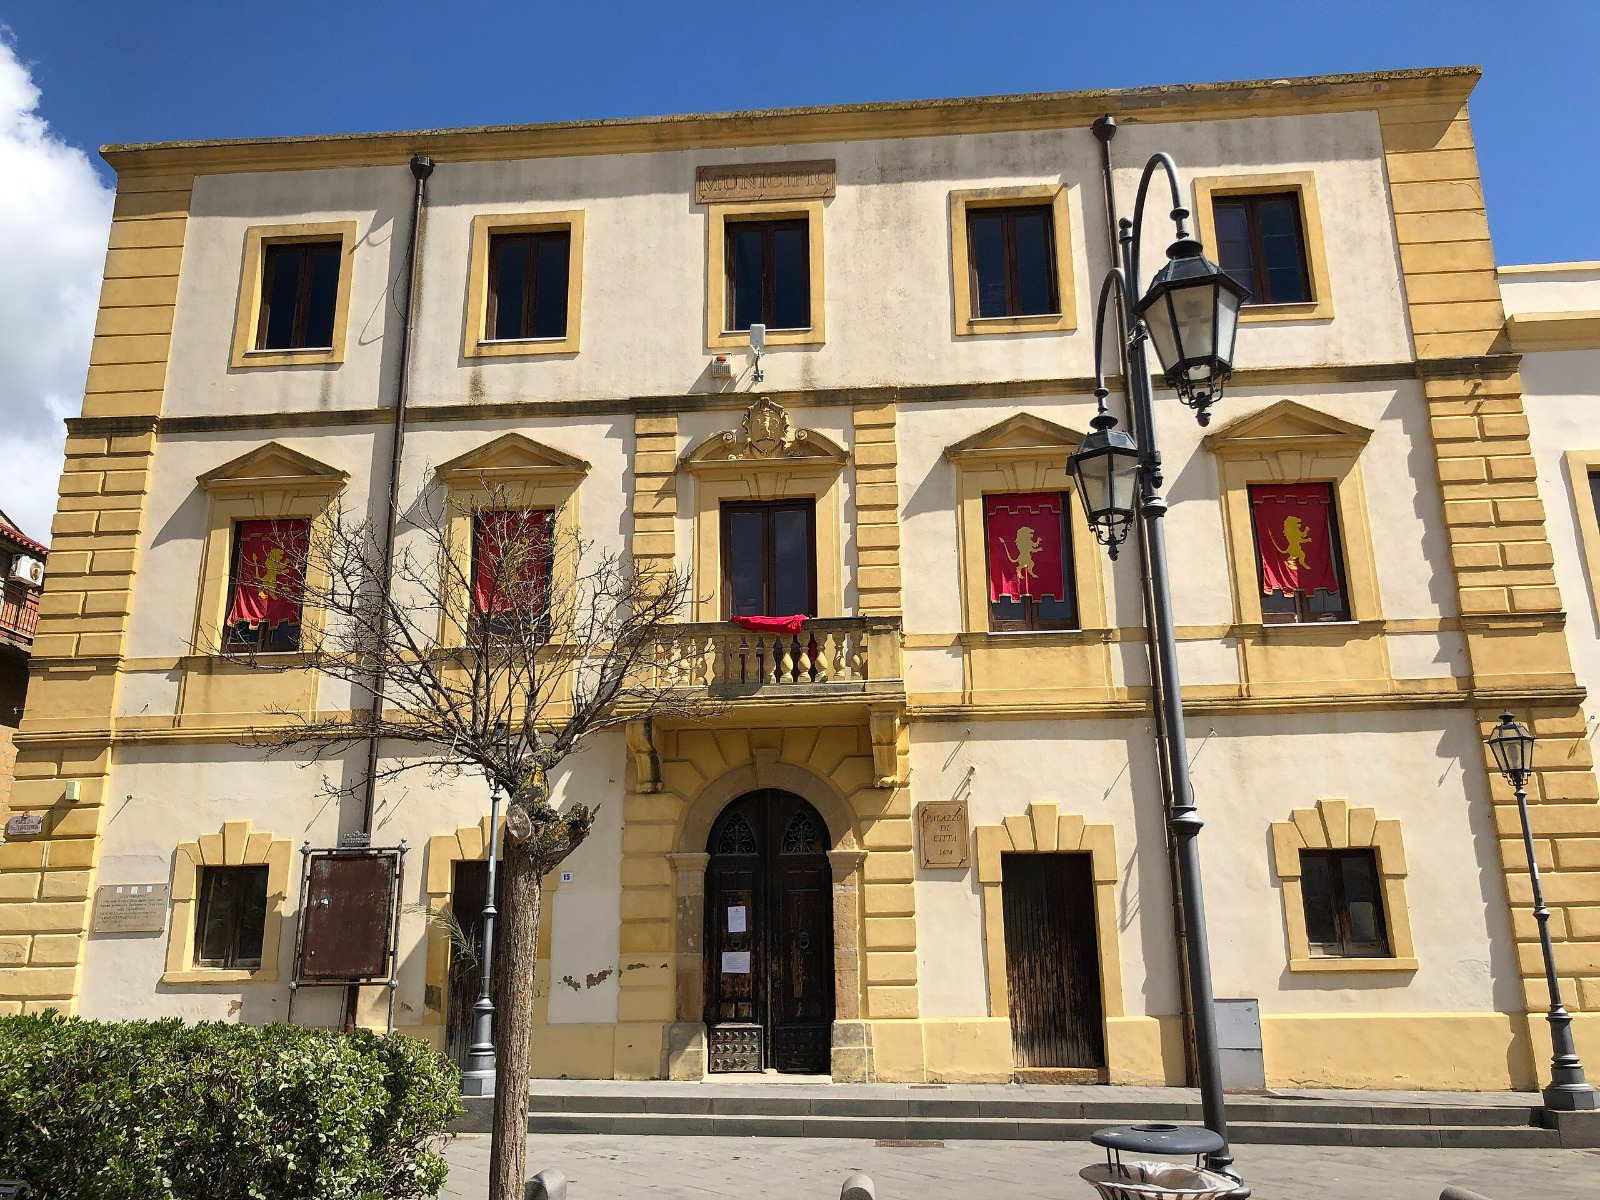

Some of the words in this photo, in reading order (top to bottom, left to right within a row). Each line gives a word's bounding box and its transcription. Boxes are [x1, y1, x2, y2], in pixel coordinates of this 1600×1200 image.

[700, 170, 831, 191] MUNICIPIO
[925, 814, 963, 822] PALAZZO
[940, 824, 950, 832] DI
[563, 873, 571, 881] 15
